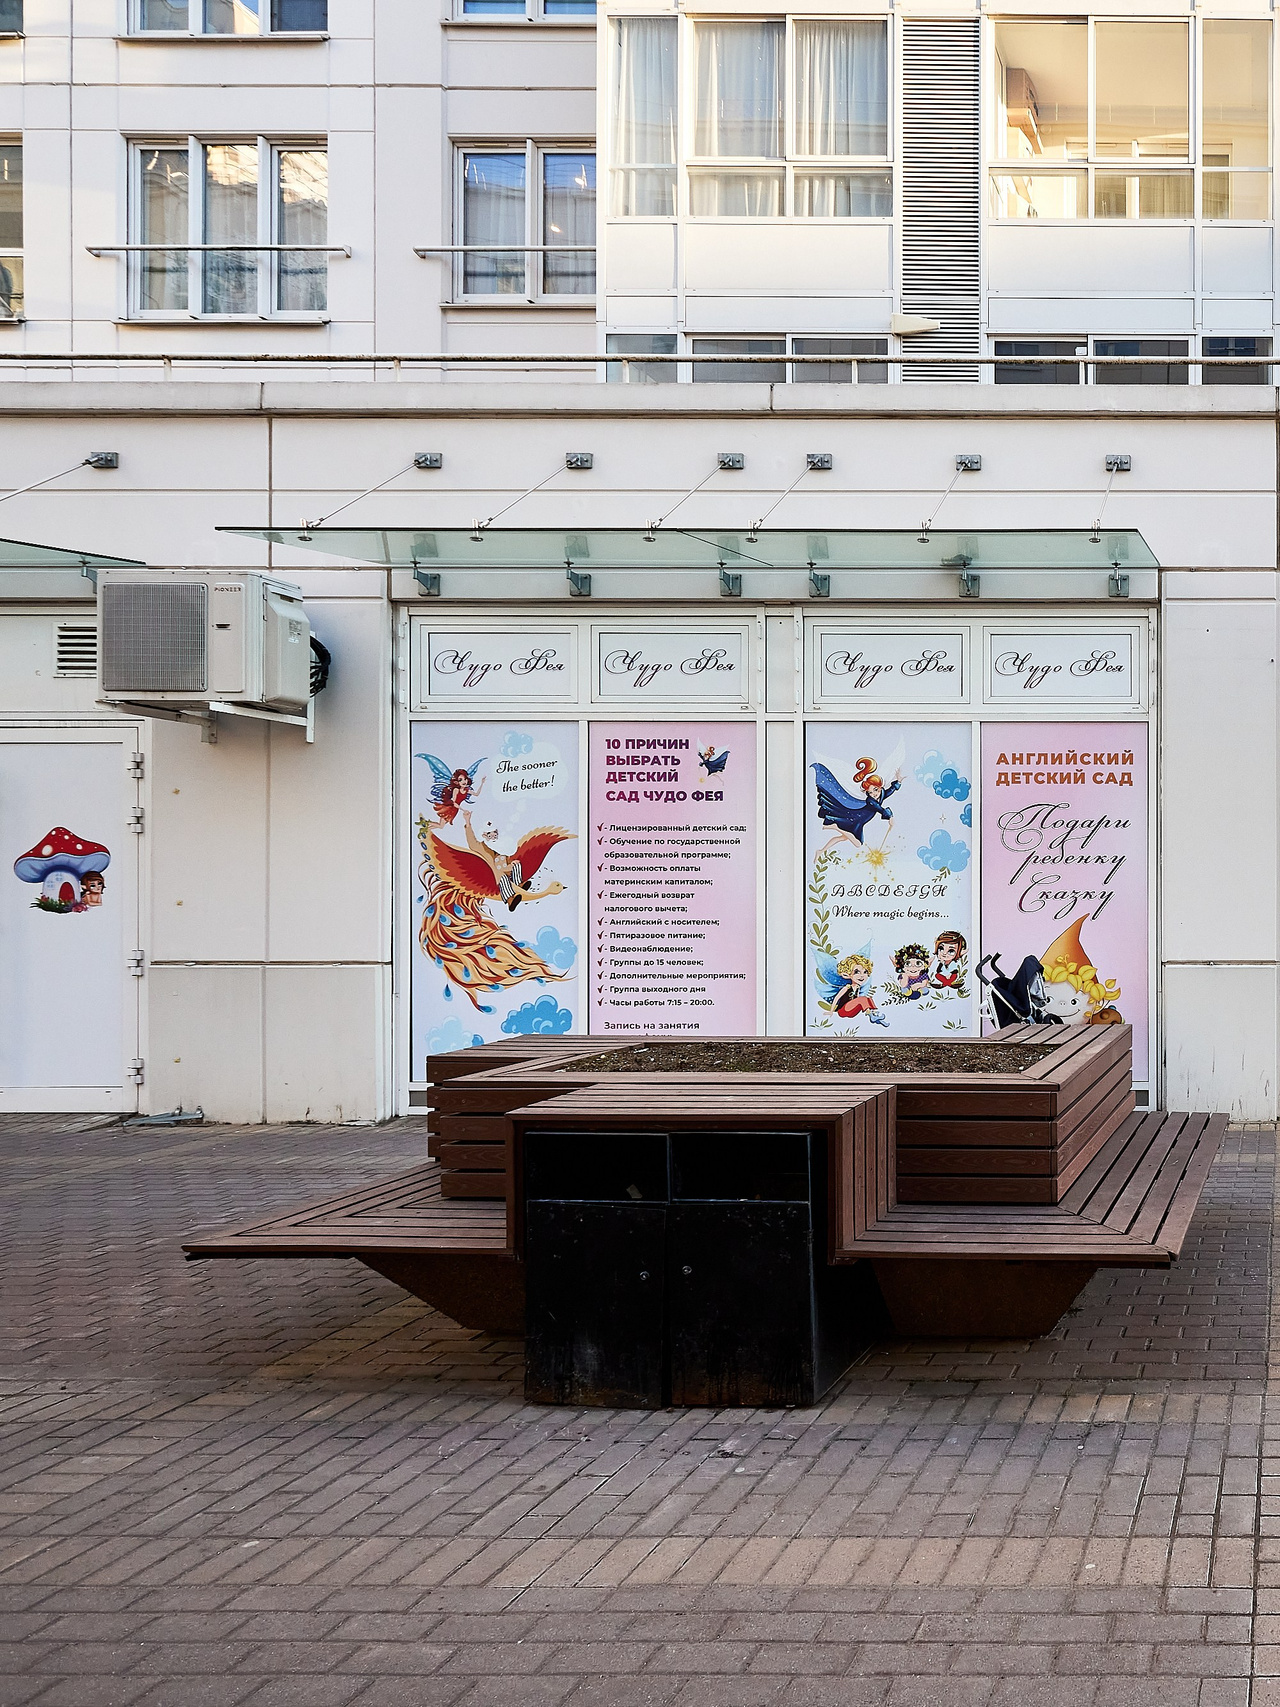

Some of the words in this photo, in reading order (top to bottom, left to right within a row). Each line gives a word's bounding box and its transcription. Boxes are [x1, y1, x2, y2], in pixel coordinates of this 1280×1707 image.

[434, 650, 502, 687] Чудо
[510, 649, 565, 675] Фея
[604, 650, 672, 687] Чудо
[680, 649, 735, 675] Фея
[826, 651, 893, 688] Чудо
[901, 650, 956, 676] Фея
[995, 652, 1062, 688] Чудо
[1070, 650, 1124, 676] Фея
[605, 739, 620, 749] 10
[626, 739, 689, 749] ПРИЧИН
[606, 756, 680, 765] ВЫБРАТЬ
[996, 750, 1133, 765] АНГЛИЙСКИЙ
[496, 760, 519, 775] The
[522, 760, 557, 770] sooner
[502, 780, 518, 792] the
[520, 775, 555, 790] better!
[606, 769, 678, 784] ДЕТСКИЙ
[996, 769, 1085, 786] ДЕТСКИЙ
[1092, 772, 1133, 786] САД
[606, 791, 639, 803] САД
[644, 791, 687, 803] ЧУДО
[692, 790, 723, 801] ФЕЯ
[998, 803, 1132, 851] Подари
[610, 838, 652, 846] Обучение
[667, 838, 740, 846] государственной
[604, 851, 678, 859] образовательной
[1008, 837, 1127, 885] ребенку
[1017, 872, 1116, 920] Сказку
[832, 905, 870, 917] Where
[873, 909, 904, 920] magic
[907, 906, 948, 920] begins...
[610, 932, 665, 940] Пятиразовое
[610, 959, 641, 967] Группы
[610, 986, 639, 994] Группа
[634, 999, 664, 1007] работы
